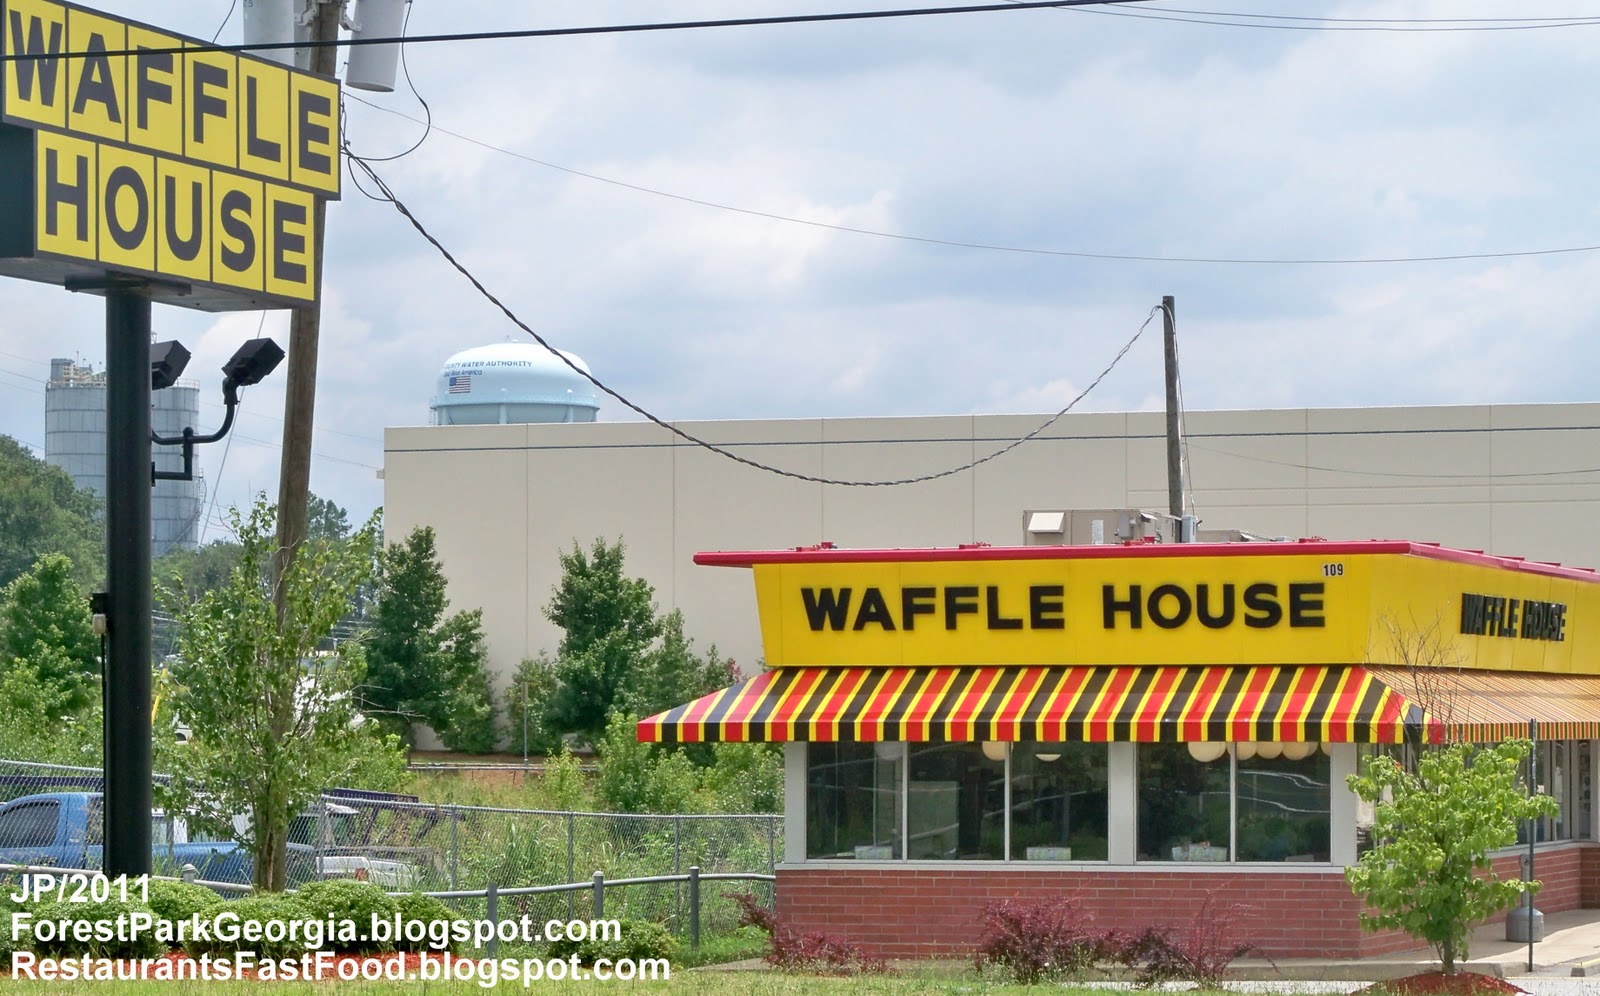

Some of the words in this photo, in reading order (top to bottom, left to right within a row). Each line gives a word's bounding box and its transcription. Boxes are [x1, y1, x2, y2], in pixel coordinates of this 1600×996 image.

[9, 9, 331, 175] WAFFLE
[45, 147, 306, 284] HOUSE
[1323, 564, 1344, 576] 109
[801, 585, 1065, 631] WAFFLE
[1102, 583, 1326, 629] HOUSE
[1460, 593, 1520, 638] WAFFLE
[1521, 600, 1567, 641] HOUSE
